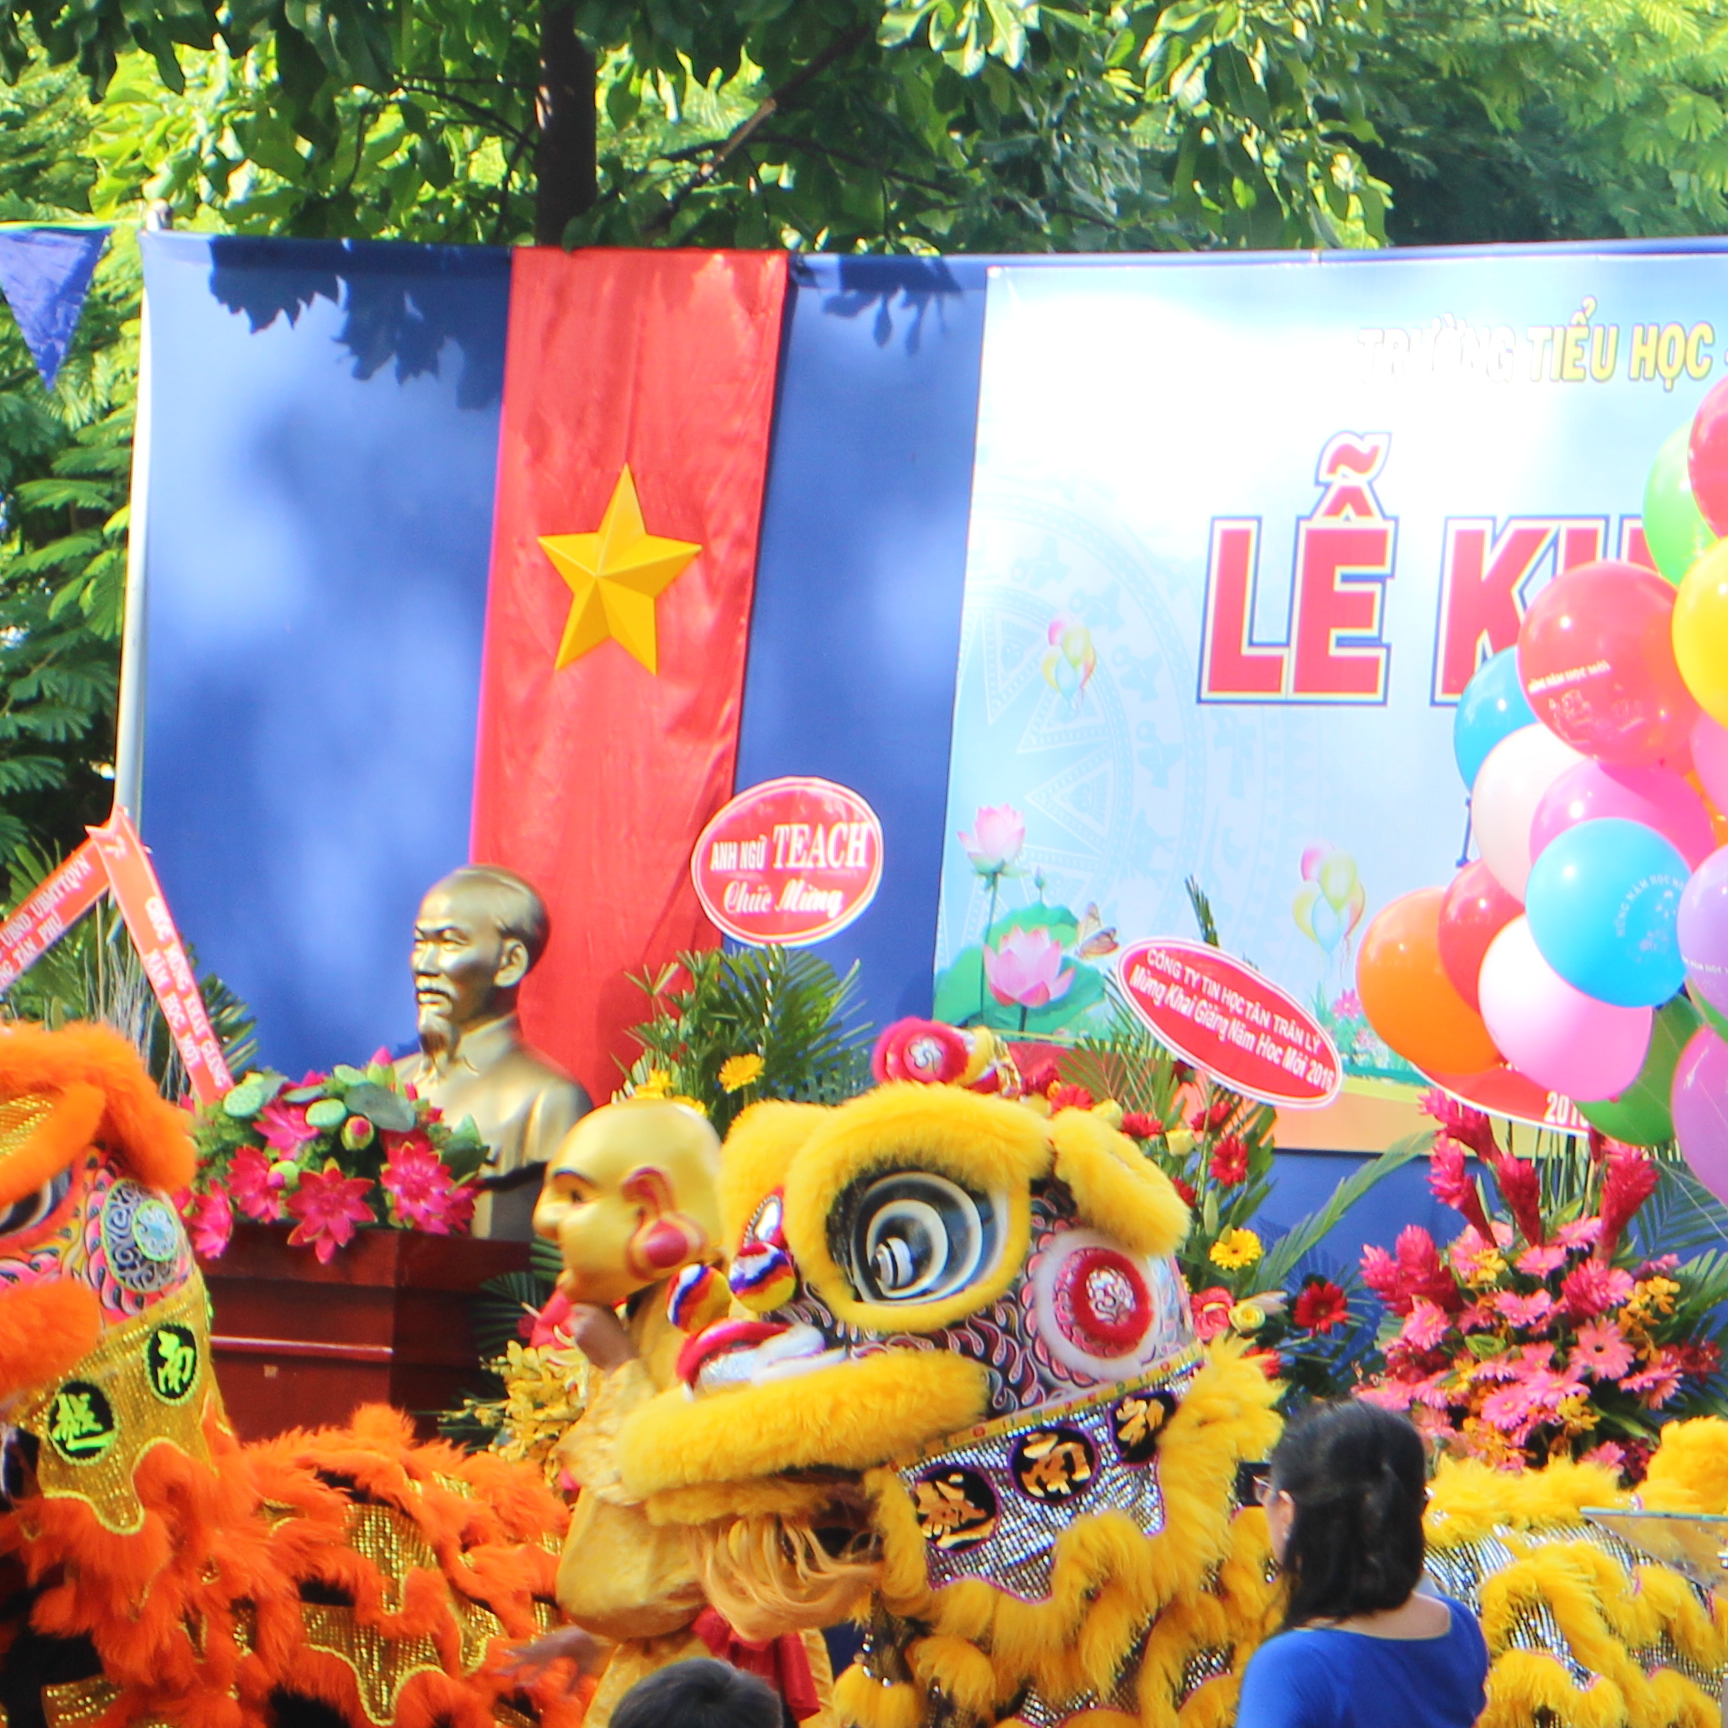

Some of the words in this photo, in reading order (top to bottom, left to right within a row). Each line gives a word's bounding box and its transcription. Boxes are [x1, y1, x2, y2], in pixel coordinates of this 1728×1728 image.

[1527, 295, 1620, 383] TIỂU
[1628, 320, 1715, 393] HỌC
[1196, 430, 1399, 706] LỄ
[772, 822, 870, 870] TEACH
[724, 880, 772, 914] Chúc
[775, 879, 843, 918] Mừng
[1130, 964, 1166, 1005] Mừng
[1165, 980, 1194, 1016] Khai
[1147, 949, 1182, 983] CÔNG
[1183, 967, 1202, 990] TY
[1201, 976, 1220, 998] TIN
[1220, 984, 1245, 1014] HỌC
